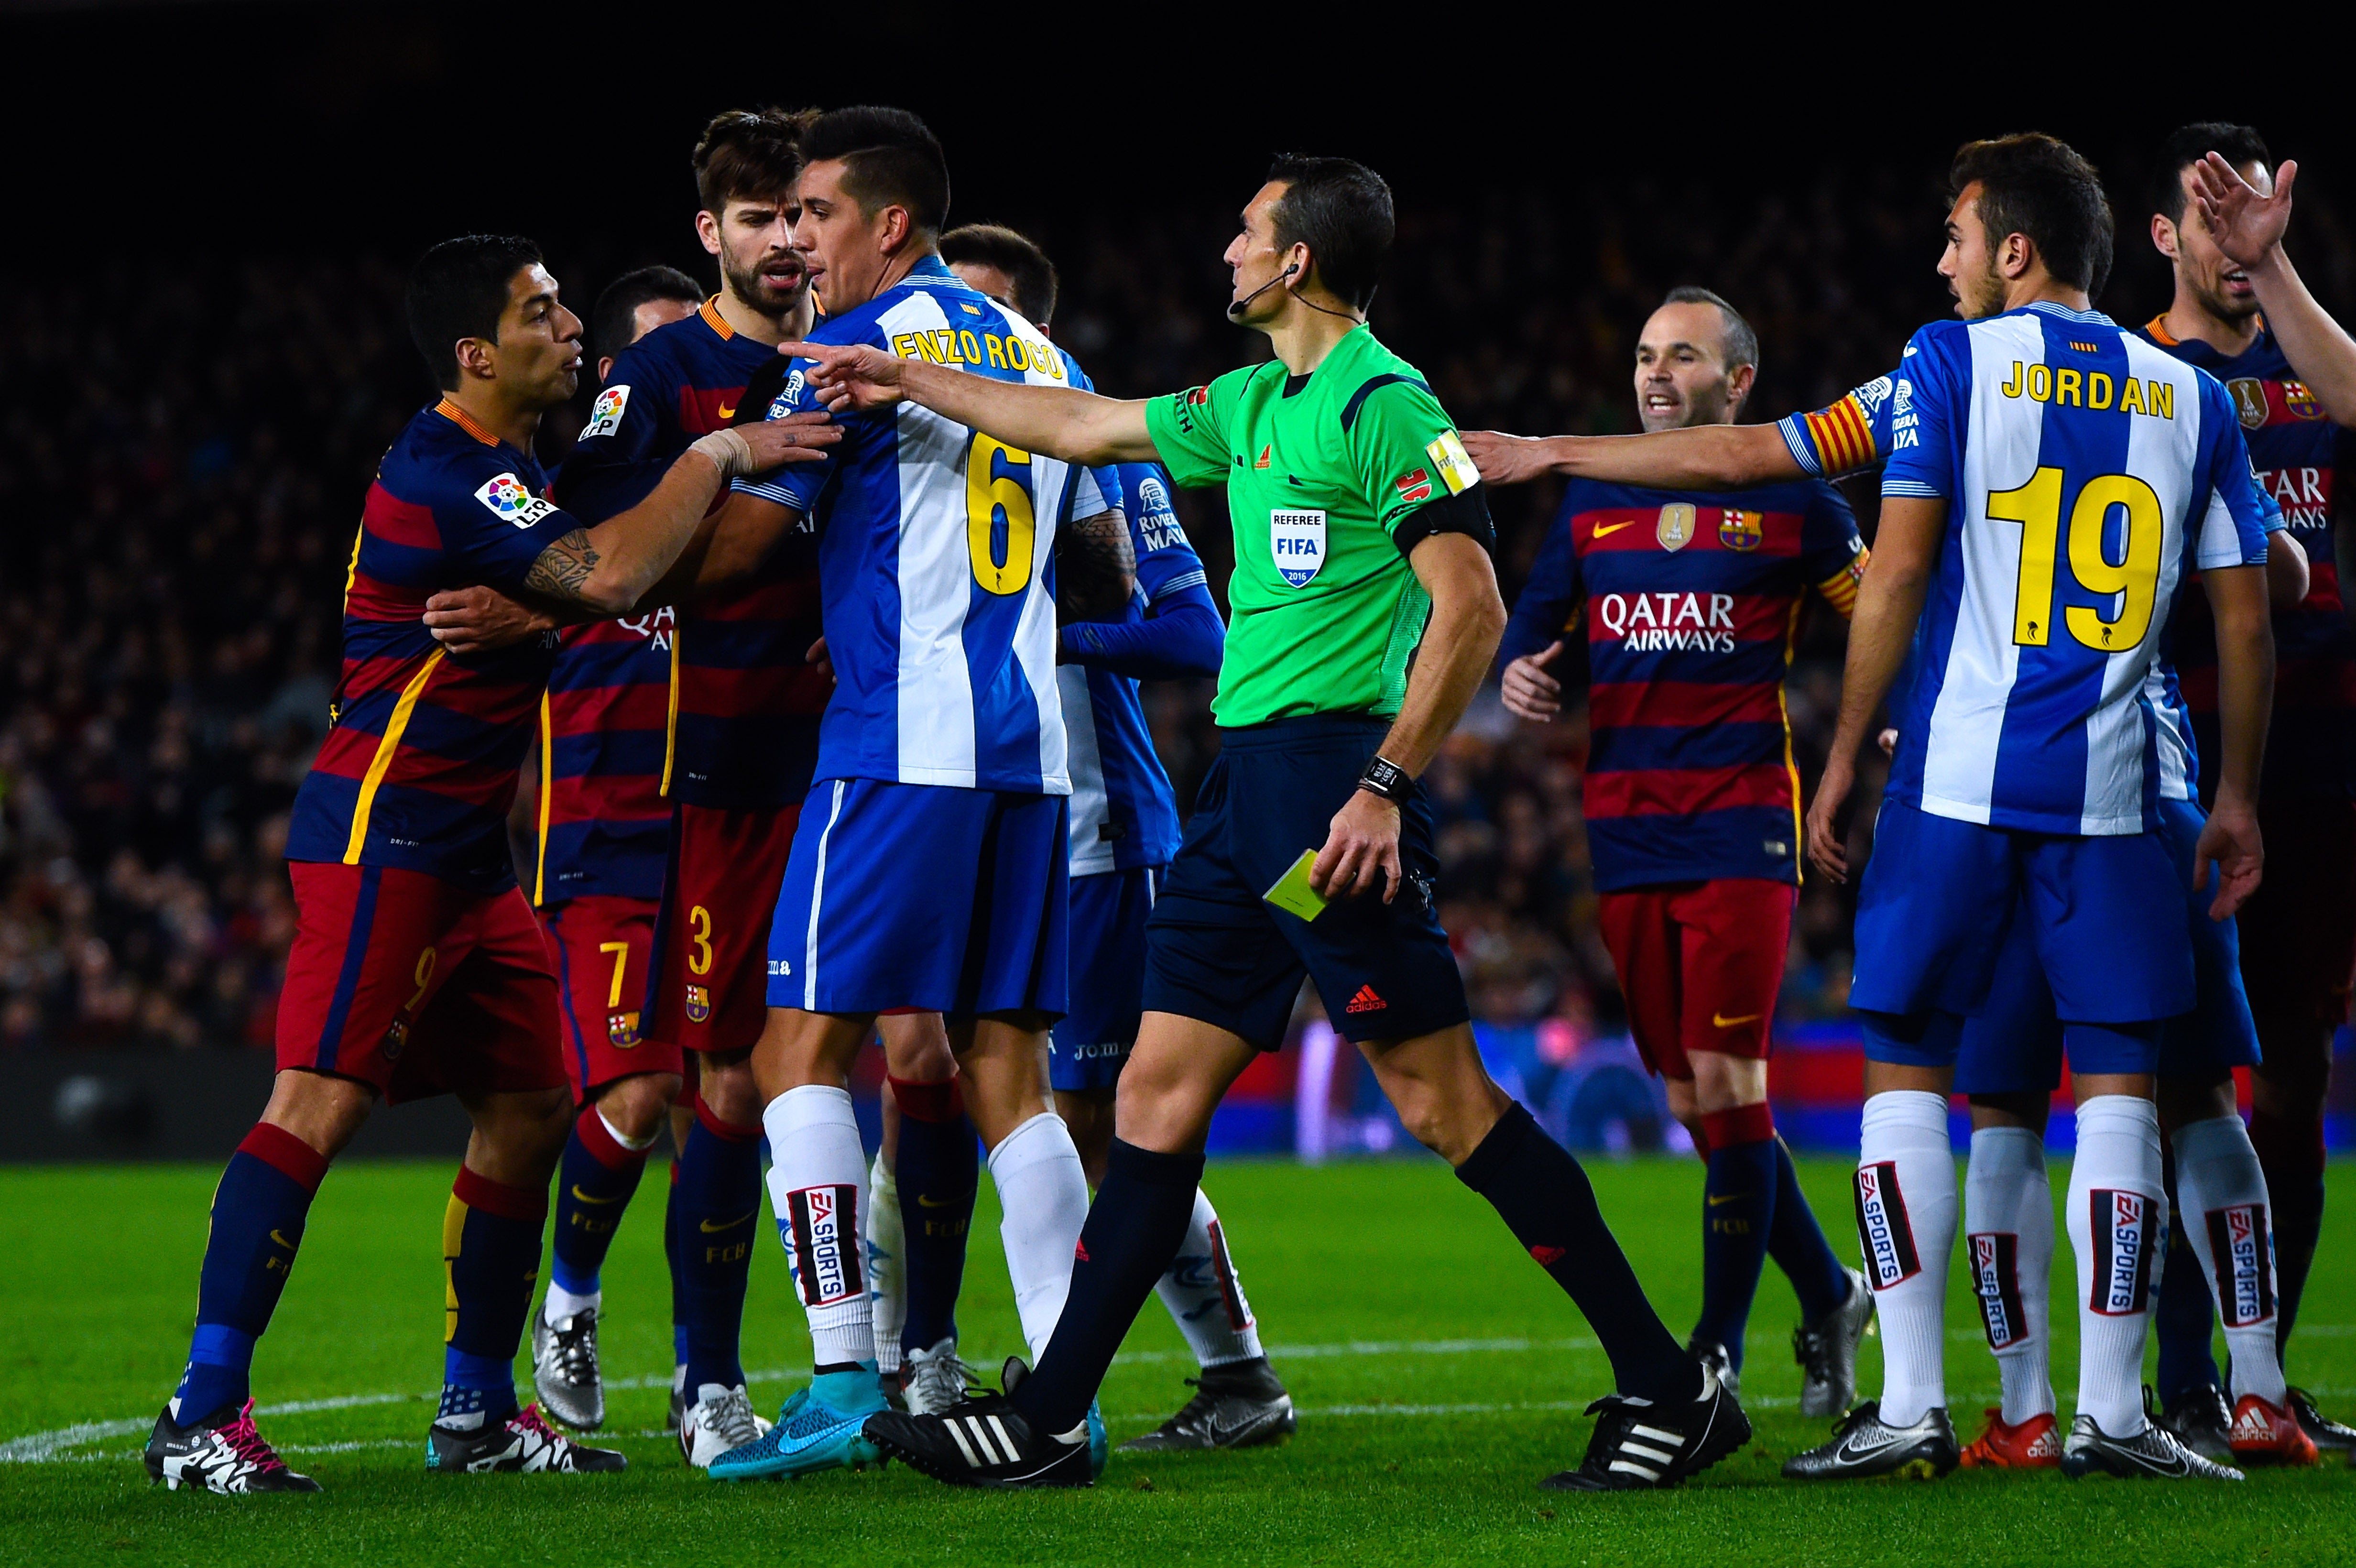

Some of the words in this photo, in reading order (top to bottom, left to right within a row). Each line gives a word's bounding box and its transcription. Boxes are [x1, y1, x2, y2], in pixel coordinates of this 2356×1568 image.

[893, 329, 982, 365] ENZO
[984, 333, 1063, 380] ROCO
[2002, 360, 2174, 420] JORDAN
[965, 431, 1036, 596] 6
[1274, 515, 1321, 525] REFEREE
[1277, 538, 1318, 555] FIFA
[1985, 466, 2163, 653] 19
[1288, 572, 1307, 581] 2016
[1601, 592, 1735, 637] QATAR
[1623, 629, 1735, 653] AIRWAYS
[688, 905, 712, 975] 3
[404, 946, 436, 1012] 9
[600, 941, 629, 1008] 7
[1346, 1000, 1387, 1013] adidas
[809, 1192, 832, 1225] EA
[1860, 1172, 1876, 1204] EA
[2116, 1193, 2139, 1227] EA
[1865, 1201, 1898, 1280] SPORTS
[2229, 1211, 2250, 1243] EA
[814, 1223, 842, 1295] SPORTS
[1978, 1240, 1993, 1268] EA
[2111, 1228, 2138, 1307] SPORTS
[2234, 1242, 2258, 1317] SPORTS
